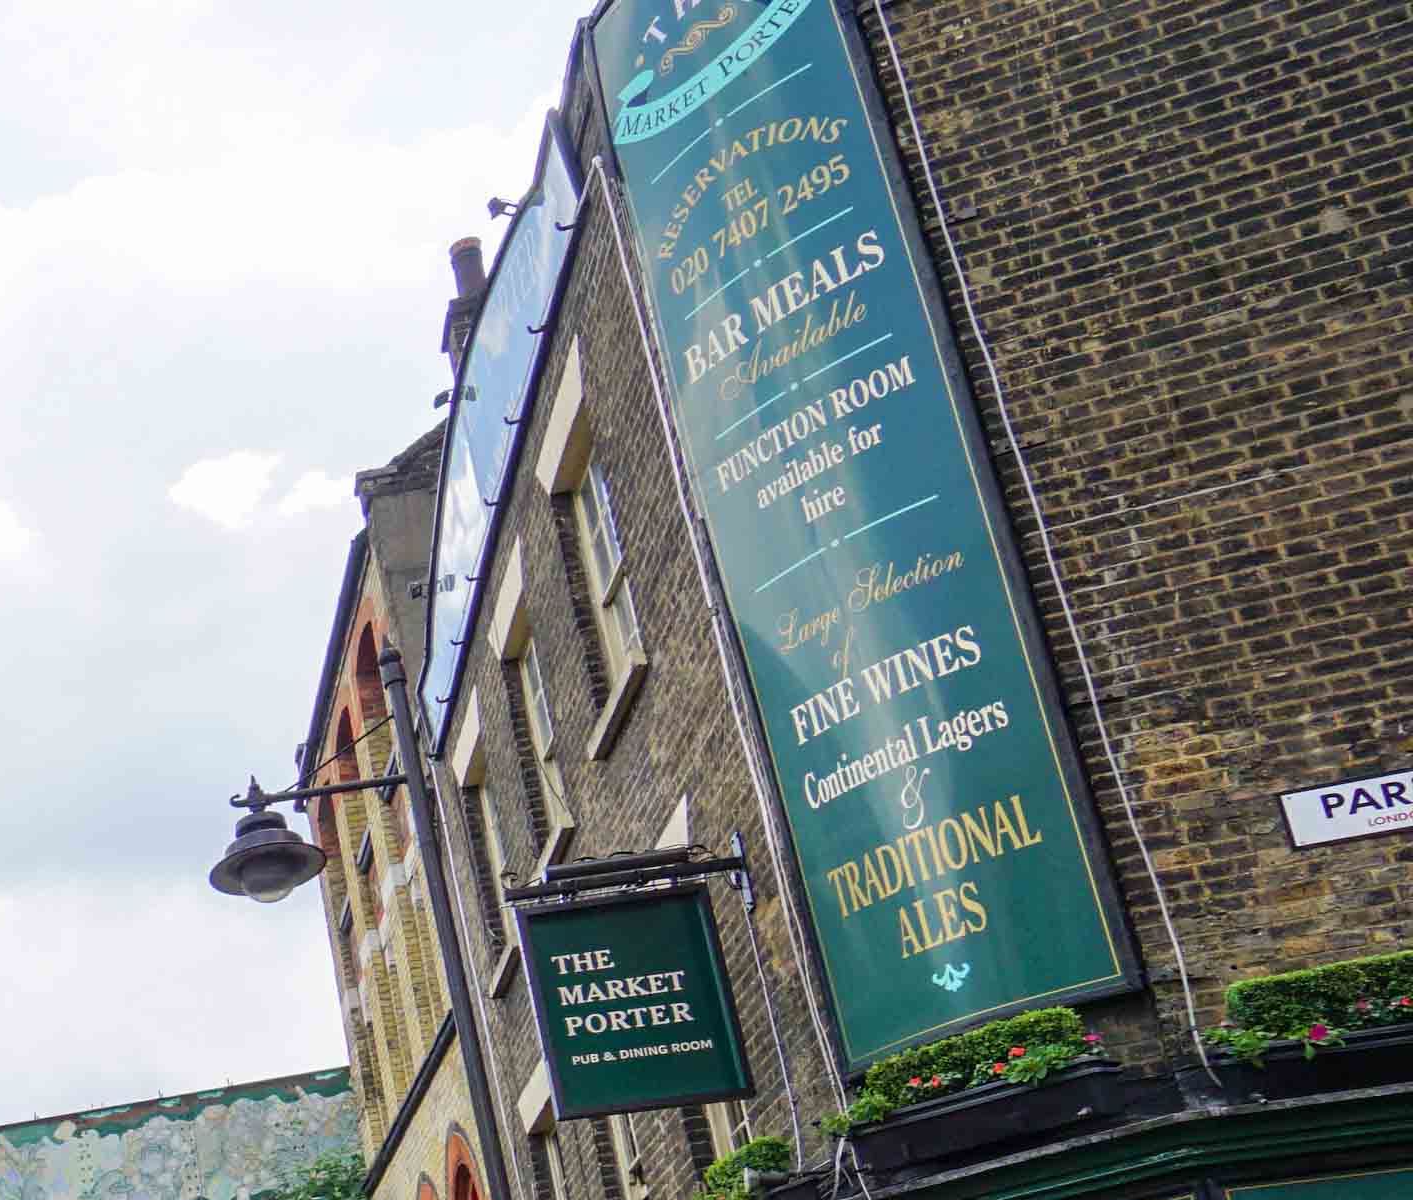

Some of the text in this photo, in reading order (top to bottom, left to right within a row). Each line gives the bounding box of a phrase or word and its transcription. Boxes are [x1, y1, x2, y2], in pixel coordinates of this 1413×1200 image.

[621, 0, 801, 138] MARKET PORTE
[659, 116, 849, 259] RESERVATIONS
[671, 153, 852, 297] 020 7407 2495
[722, 178, 759, 212] TEL
[683, 229, 886, 385] BAR MEALS
[718, 290, 869, 402] Available
[715, 355, 917, 493] FUNCTION ROOM
[756, 422, 884, 510] available for
[800, 484, 847, 524] hire
[777, 551, 967, 655] Large Selection
[789, 624, 982, 747] FINE WINES
[830, 626, 856, 680] of
[804, 700, 1010, 810] Continental Lagers
[1319, 776, 1413, 820] PAR
[826, 794, 1044, 920] TRADITIONAL
[550, 948, 616, 976] THE
[898, 880, 989, 960] ALES
[556, 969, 686, 1007] MARKET
[563, 1002, 695, 1038] PORTER
[571, 1038, 715, 1066] PUB & DINING ROOM
